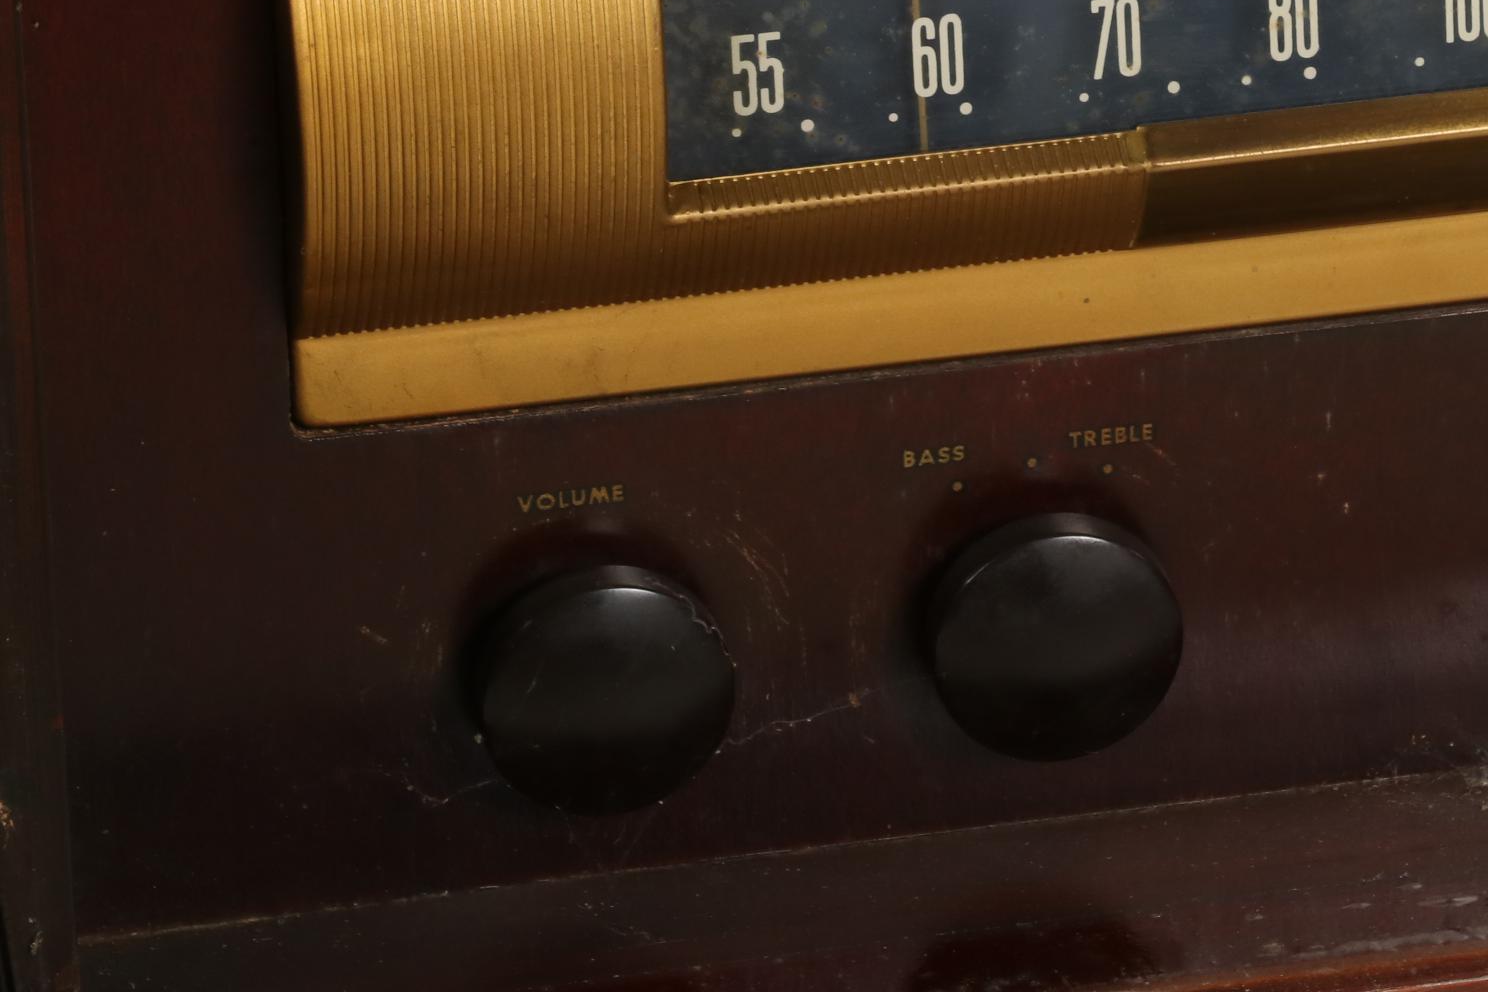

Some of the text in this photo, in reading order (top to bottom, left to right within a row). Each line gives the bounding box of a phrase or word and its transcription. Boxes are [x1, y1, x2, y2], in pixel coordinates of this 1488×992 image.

[730, 30, 785, 116] 55
[911, 13, 965, 98] 60
[1069, 423, 1154, 449] TREBLE
[903, 445, 966, 468] BASS
[516, 483, 626, 513] VOLUME
